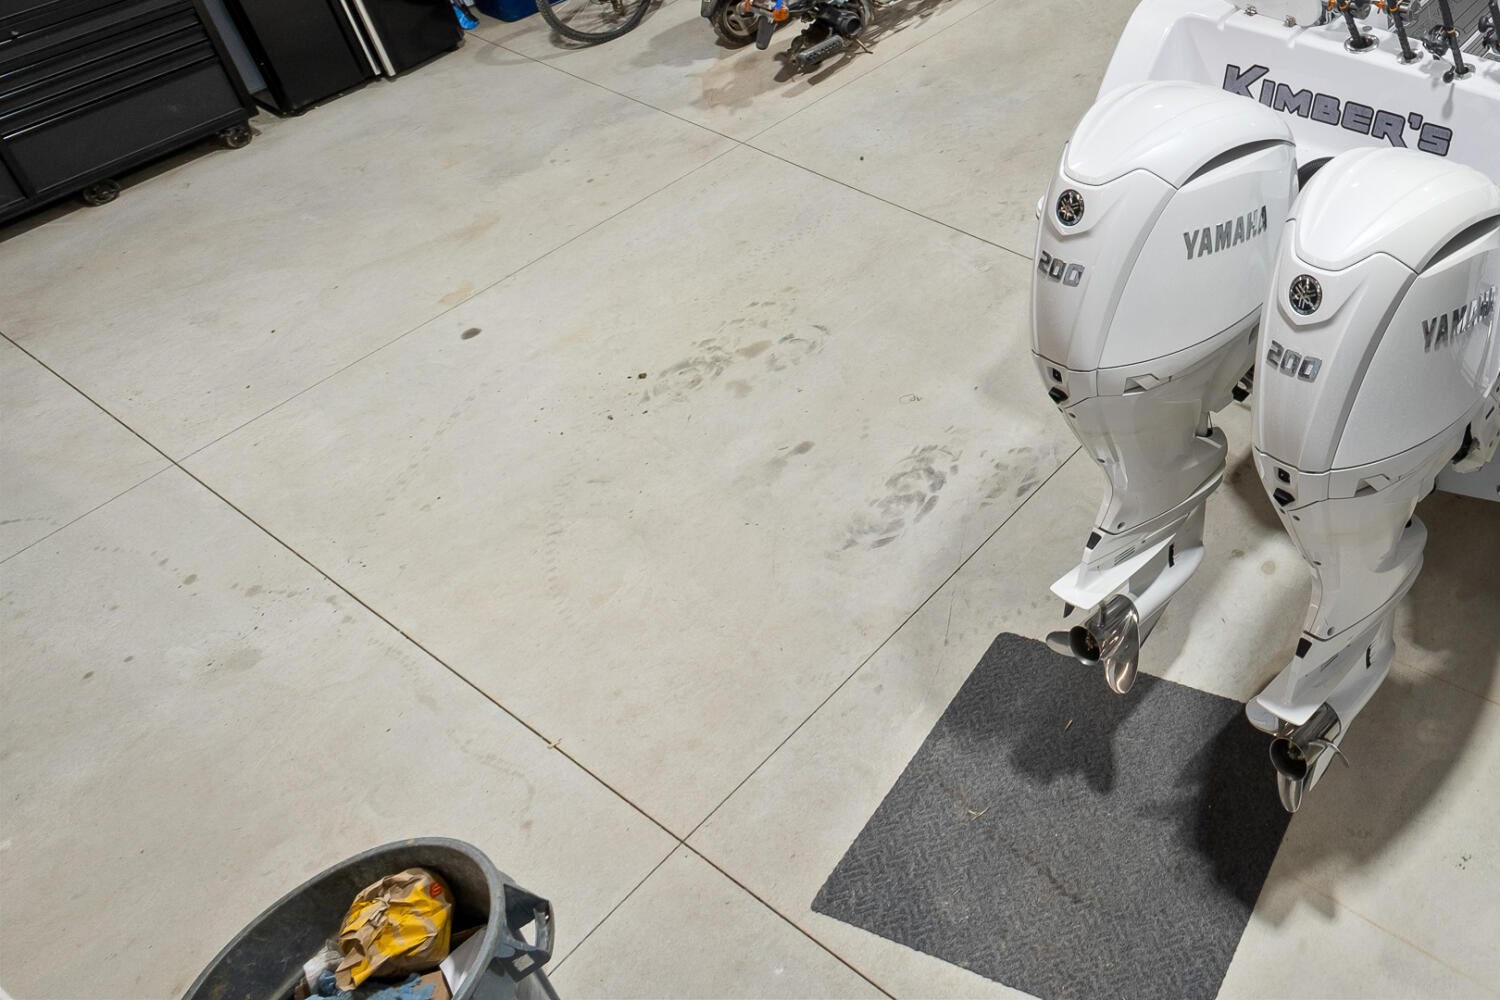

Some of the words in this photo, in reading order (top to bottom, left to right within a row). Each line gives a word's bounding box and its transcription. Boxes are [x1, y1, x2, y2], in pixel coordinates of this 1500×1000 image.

[1183, 206, 1268, 260] YAMAHA
[1038, 250, 1085, 287] 200
[1266, 339, 1323, 382] 200
